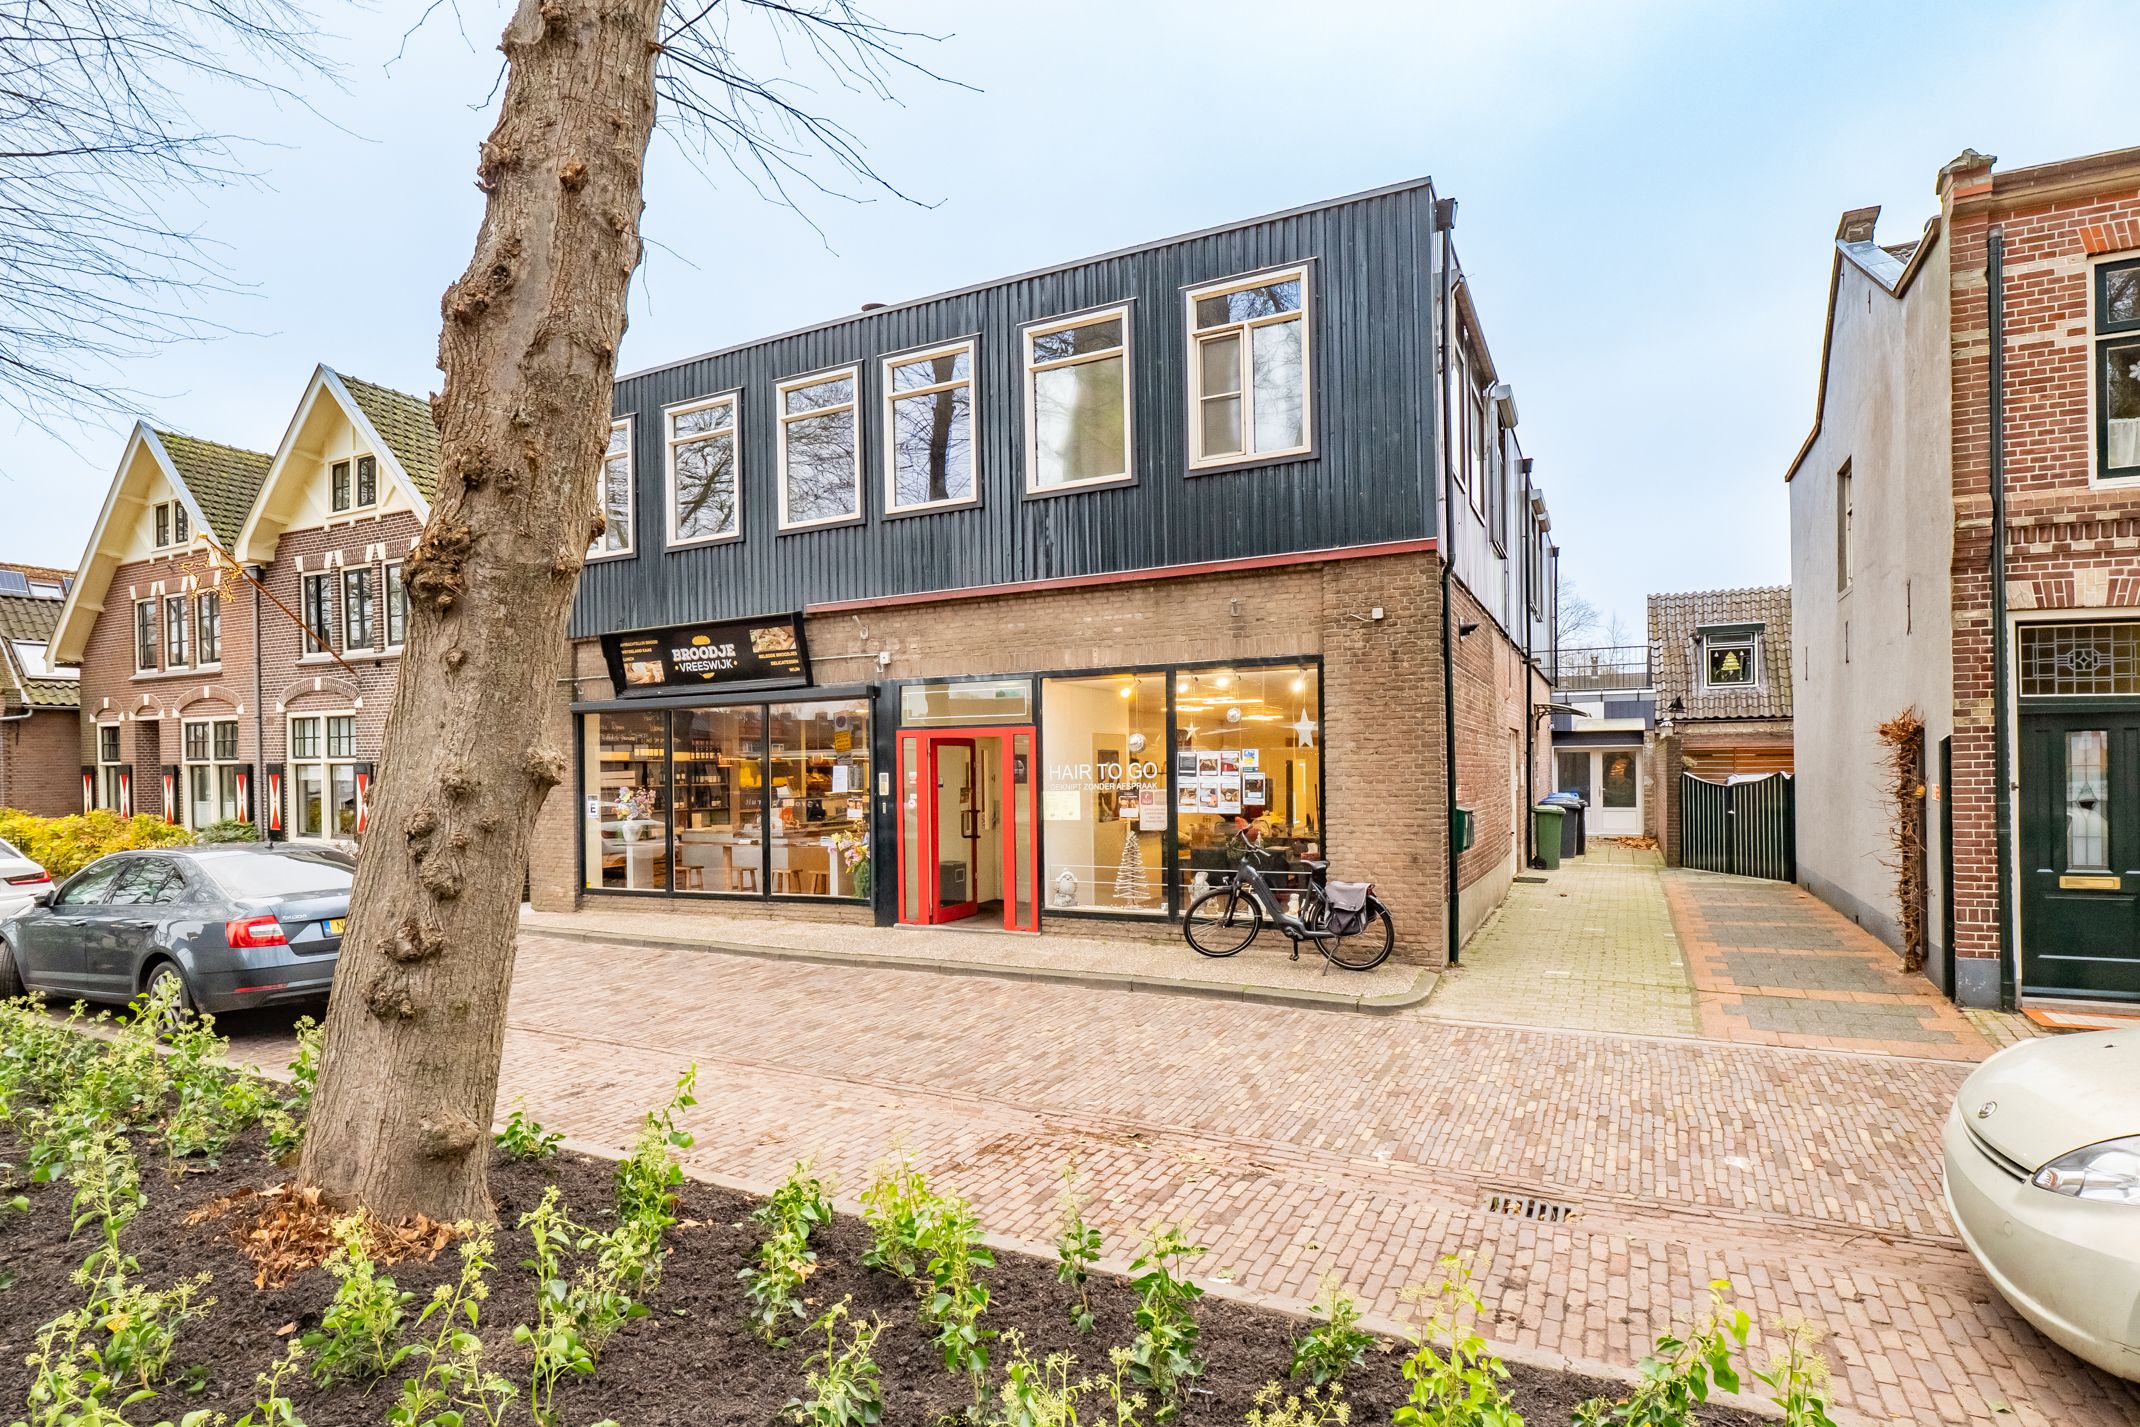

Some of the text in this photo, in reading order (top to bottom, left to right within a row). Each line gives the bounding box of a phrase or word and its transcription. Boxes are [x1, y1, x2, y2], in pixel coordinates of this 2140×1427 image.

[671, 643, 736, 662] BROODJE
[679, 658, 734, 672] VREESWIJK
[1049, 762, 1158, 780] HAIR TO GO
[1116, 782, 1158, 790] AFSPRAAK
